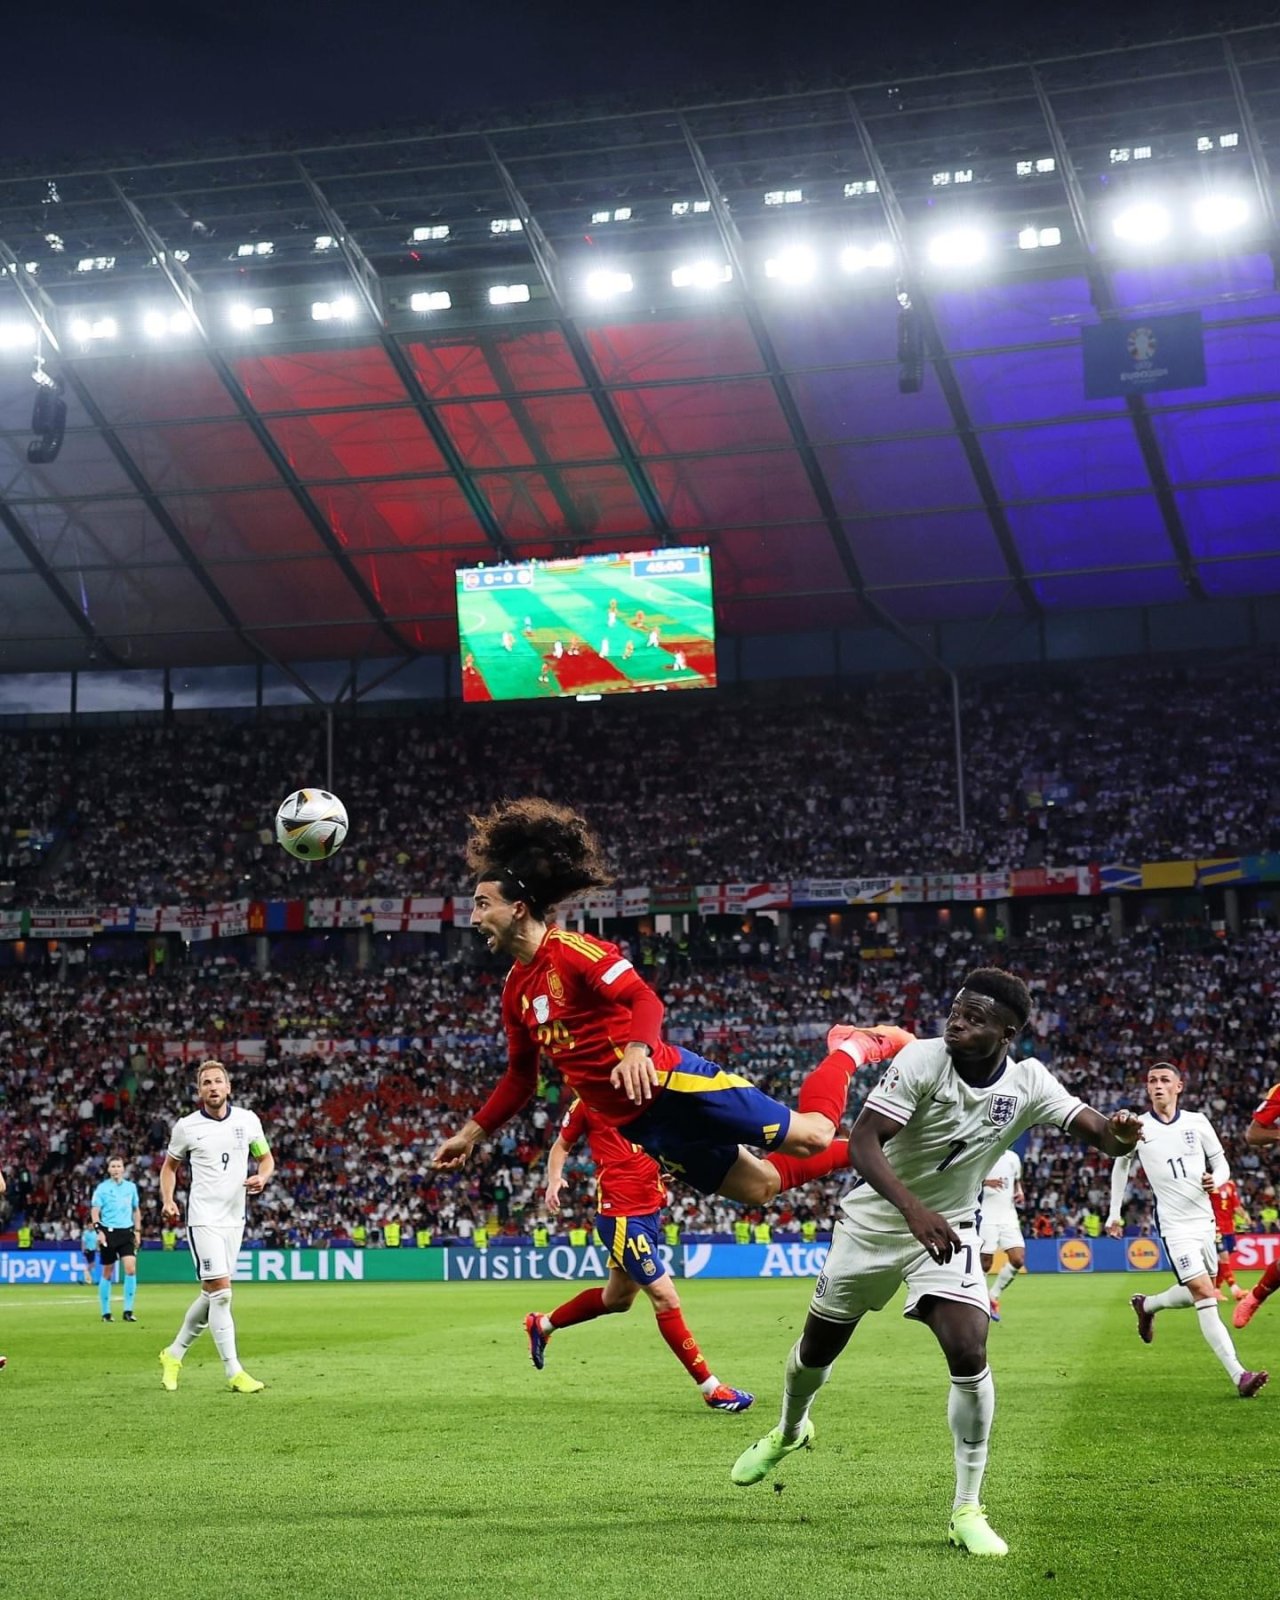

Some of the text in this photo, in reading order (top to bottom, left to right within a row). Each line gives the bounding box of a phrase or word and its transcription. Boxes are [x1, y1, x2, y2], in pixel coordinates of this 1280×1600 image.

[222, 1152, 229, 1171] 9
[936, 1140, 967, 1171] 7
[1167, 1157, 1187, 1179] 11
[627, 1234, 651, 1260] 14
[961, 1244, 972, 1274] 7
